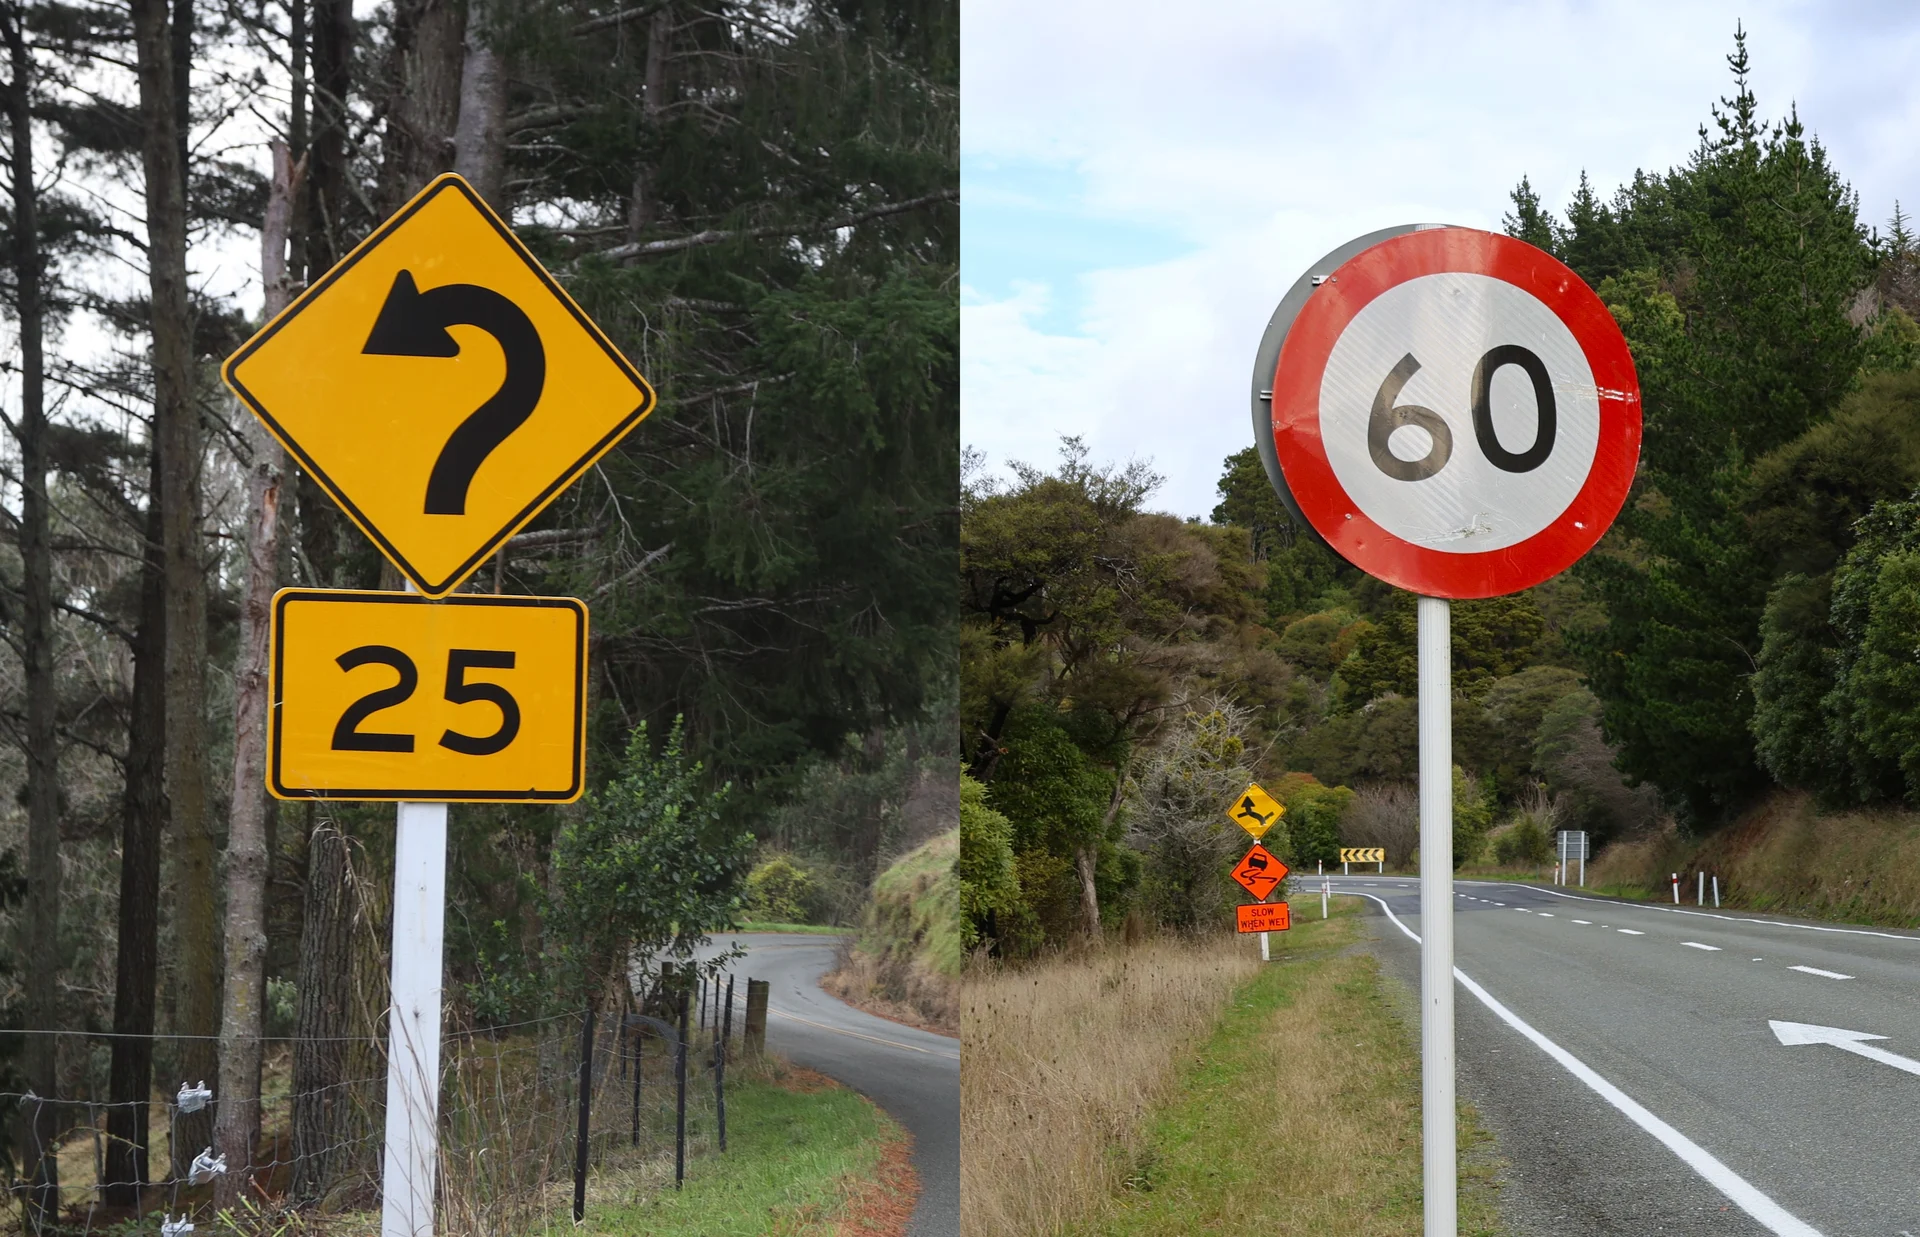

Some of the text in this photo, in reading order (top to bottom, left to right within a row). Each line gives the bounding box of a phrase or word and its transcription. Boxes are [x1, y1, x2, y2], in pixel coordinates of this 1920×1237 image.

[1367, 344, 1557, 482] 60
[331, 645, 521, 756] 25
[1241, 917, 1285, 929] WHEN WET
[1251, 908, 1274, 917] SLOW
